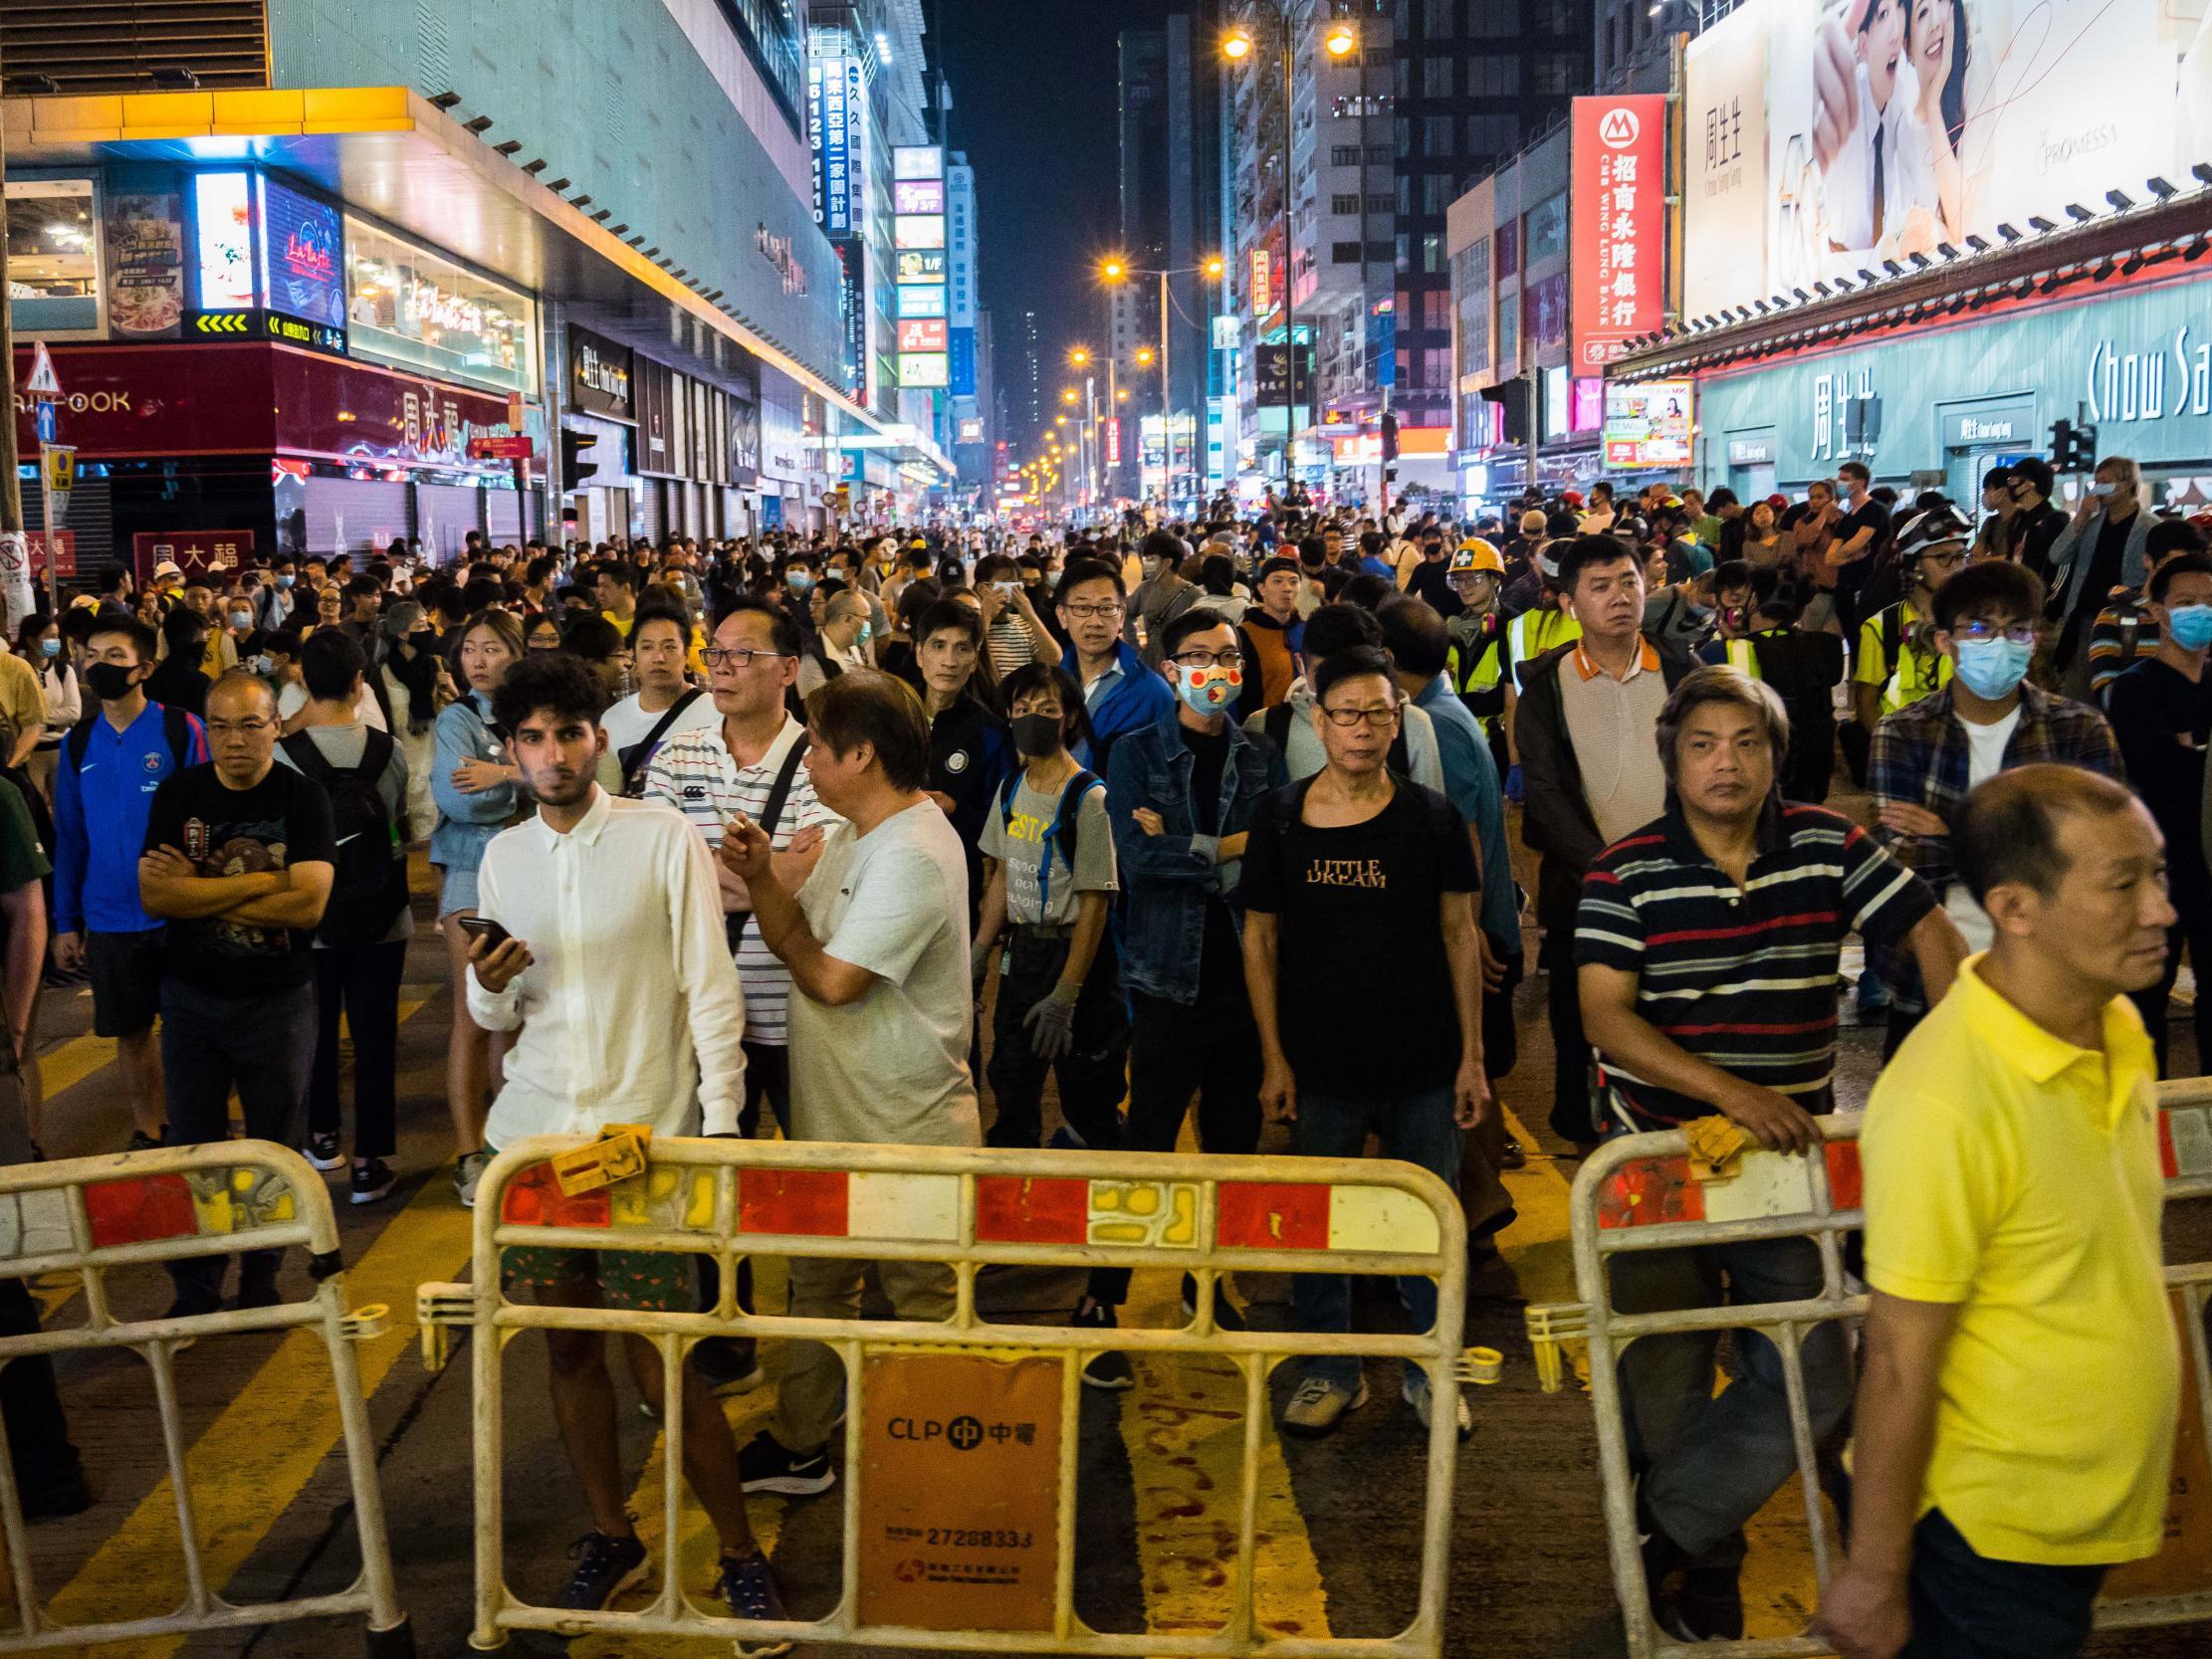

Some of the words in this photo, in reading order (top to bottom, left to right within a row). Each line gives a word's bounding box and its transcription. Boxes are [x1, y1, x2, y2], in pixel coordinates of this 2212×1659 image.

[826, 61, 845, 229] 馬來西亞第二家園計劃
[1704, 96, 1741, 172] 周生生
[2045, 122, 2117, 166] PROMESSA
[1600, 153, 1610, 186] CMB
[1600, 192, 1610, 232] WING
[1600, 239, 1610, 279] LUNG
[1611, 154, 1638, 326] 招商永隆銀行
[924, 257, 943, 271] 1/F
[1600, 286, 1610, 326] BANK
[2088, 340, 2165, 423] Chow
[152, 543, 239, 570] 周大福
[888, 1417, 943, 1442] CLP
